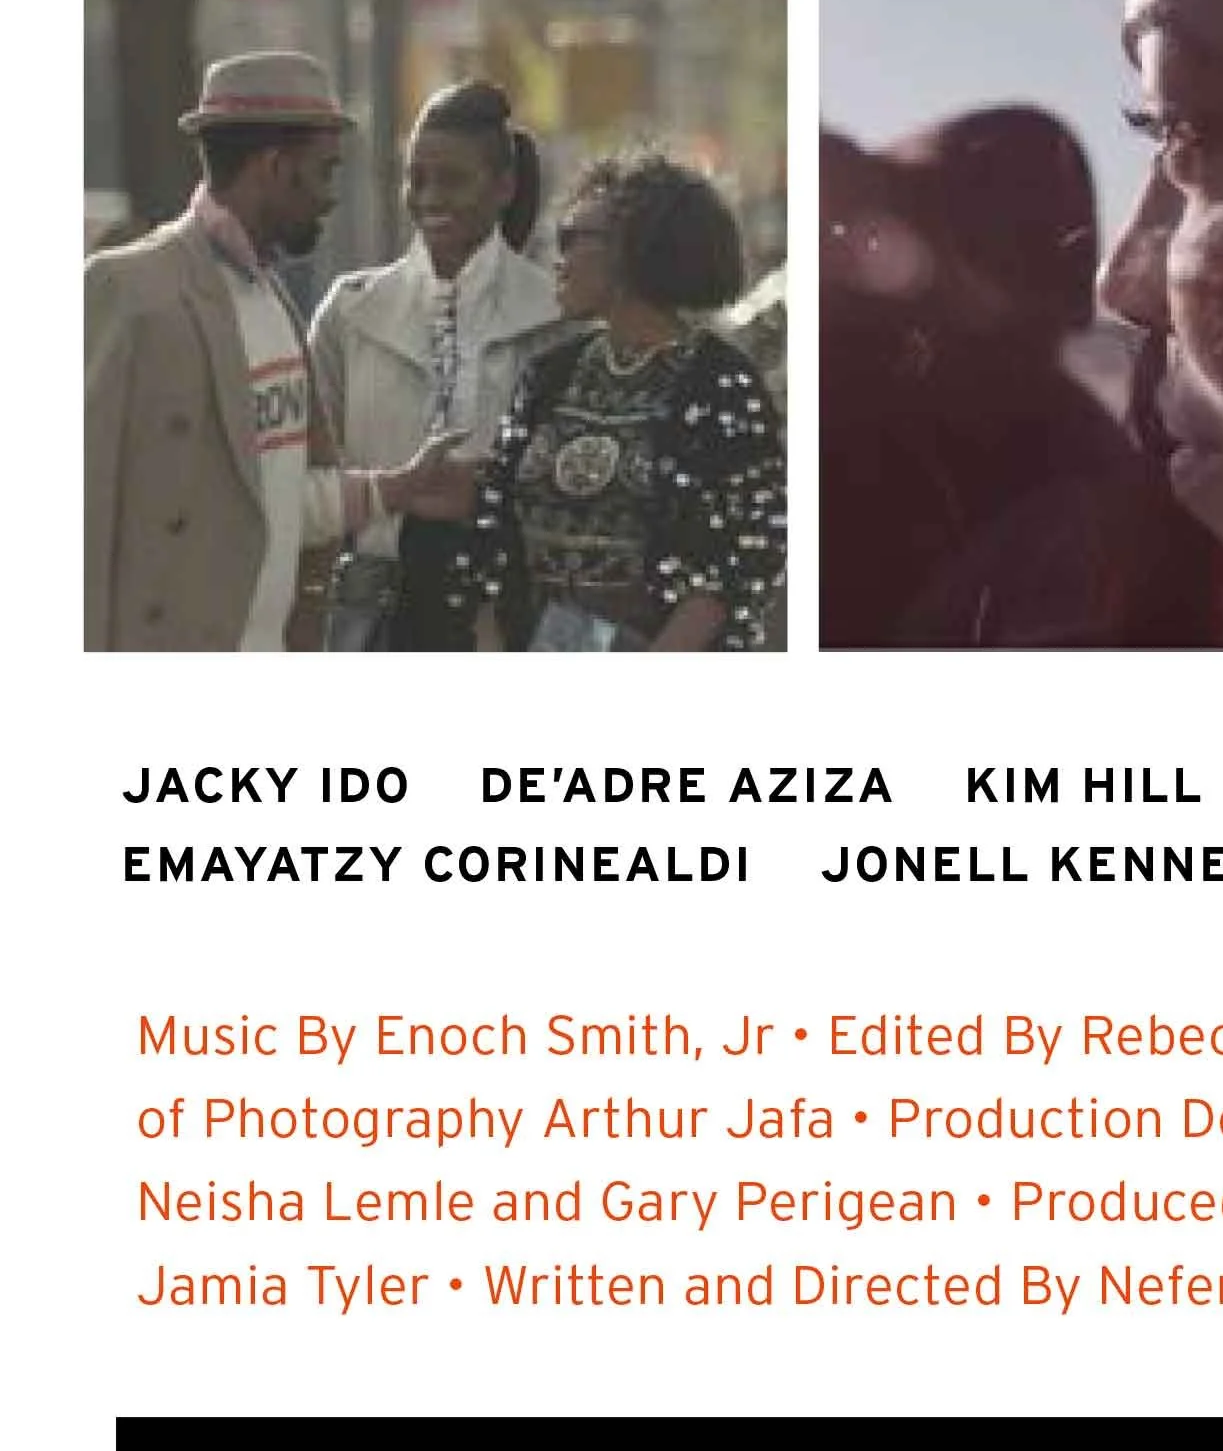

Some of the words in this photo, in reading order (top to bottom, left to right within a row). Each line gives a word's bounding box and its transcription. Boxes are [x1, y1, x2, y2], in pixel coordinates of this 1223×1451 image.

[123, 767, 298, 803] JACKY
[323, 767, 407, 803] IDO
[729, 768, 892, 802] AZIZA
[968, 768, 1058, 802] KIM
[1085, 768, 1200, 802] HILL
[125, 847, 402, 882] EMAYATZY
[425, 846, 746, 882] CORINEALDI
[822, 846, 1028, 882] JONELL
[141, 1015, 276, 1055] Music
[300, 1016, 356, 1065] By
[379, 1015, 525, 1055] Enoch
[548, 1014, 701, 1060] Smith,
[723, 1016, 773, 1055] Jr
[832, 1014, 981, 1055] Edited
[1007, 1016, 1062, 1065] By
[139, 1098, 184, 1138] of
[207, 1097, 522, 1148] Photography
[544, 1097, 707, 1138] Arthur
[727, 1098, 832, 1138] Jafa
[892, 1098, 1160, 1138] Production
[141, 1180, 302, 1221] Neisha
[327, 1180, 473, 1221] Lemle
[494, 1180, 580, 1221] and
[603, 1181, 717, 1231] Gary
[739, 1181, 954, 1230] Perigean
[138, 1265, 286, 1305] Jamia
[308, 1265, 428, 1315] Tyler
[485, 1265, 663, 1305] Written
[686, 1265, 771, 1305] and
[796, 1265, 1000, 1305] Directed
[1024, 1266, 1080, 1315] By
